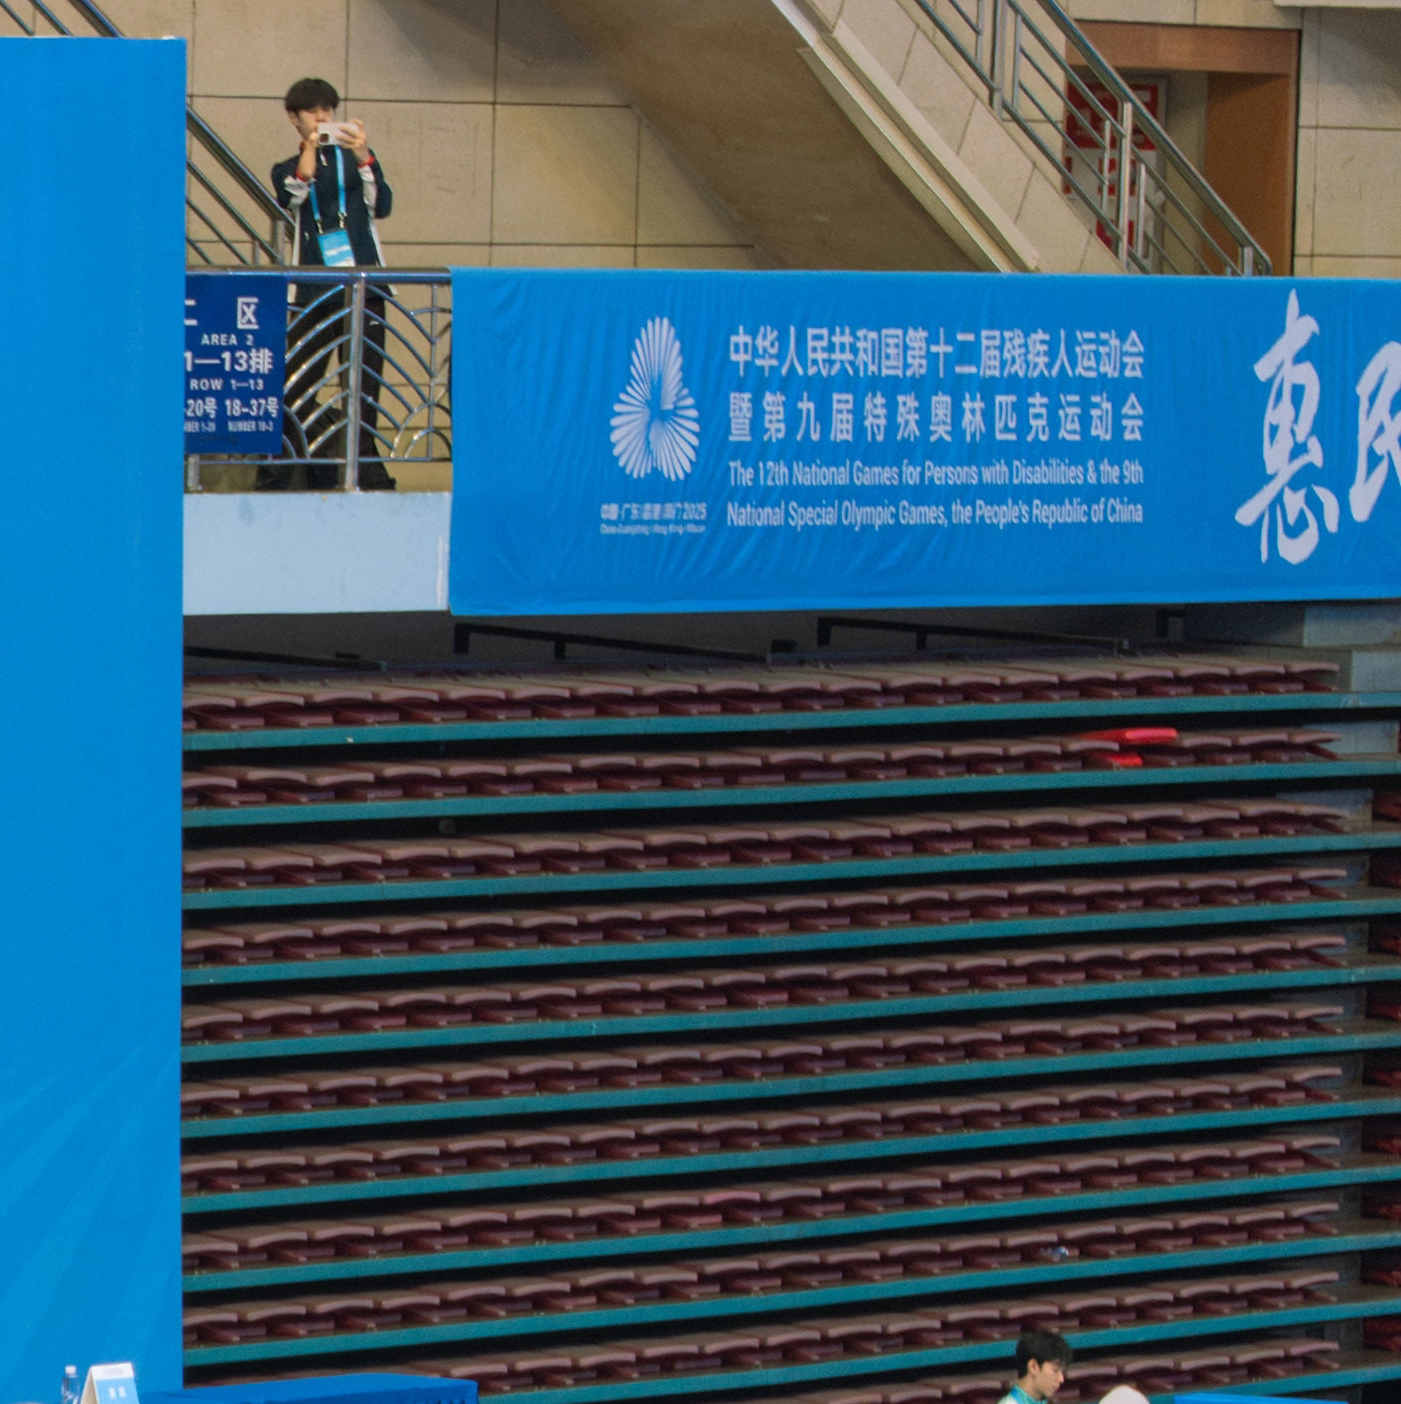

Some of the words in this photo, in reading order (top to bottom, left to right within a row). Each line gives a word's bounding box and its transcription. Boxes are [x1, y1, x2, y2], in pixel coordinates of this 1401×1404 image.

[201, 333, 237, 346] AREA
[246, 333, 254, 346] 2
[730, 325, 1144, 378] 中华人民共和国第十二届残疾人运动会
[190, 378, 223, 391] ROW
[729, 391, 1143, 442] 暨第九届特殊奥林匹克运动会
[729, 460, 754, 486] The
[759, 460, 789, 486] 12th
[793, 459, 850, 485] National
[853, 460, 899, 485] Games
[902, 459, 921, 485] for
[925, 460, 979, 485] Persons
[981, 459, 1009, 485] with
[1013, 459, 1084, 484] Disabilities
[1087, 460, 1097, 484] &
[1100, 458, 1120, 484] the
[1123, 460, 1143, 484] 9th
[727, 501, 785, 526] National
[789, 500, 838, 531] Special
[842, 500, 896, 531] Olympic
[899, 500, 948, 527] Games,
[952, 499, 973, 524] the
[976, 498, 1029, 529] People's
[1032, 498, 1088, 528] Republic
[1091, 497, 1105, 523] of
[1107, 497, 1143, 522] China
